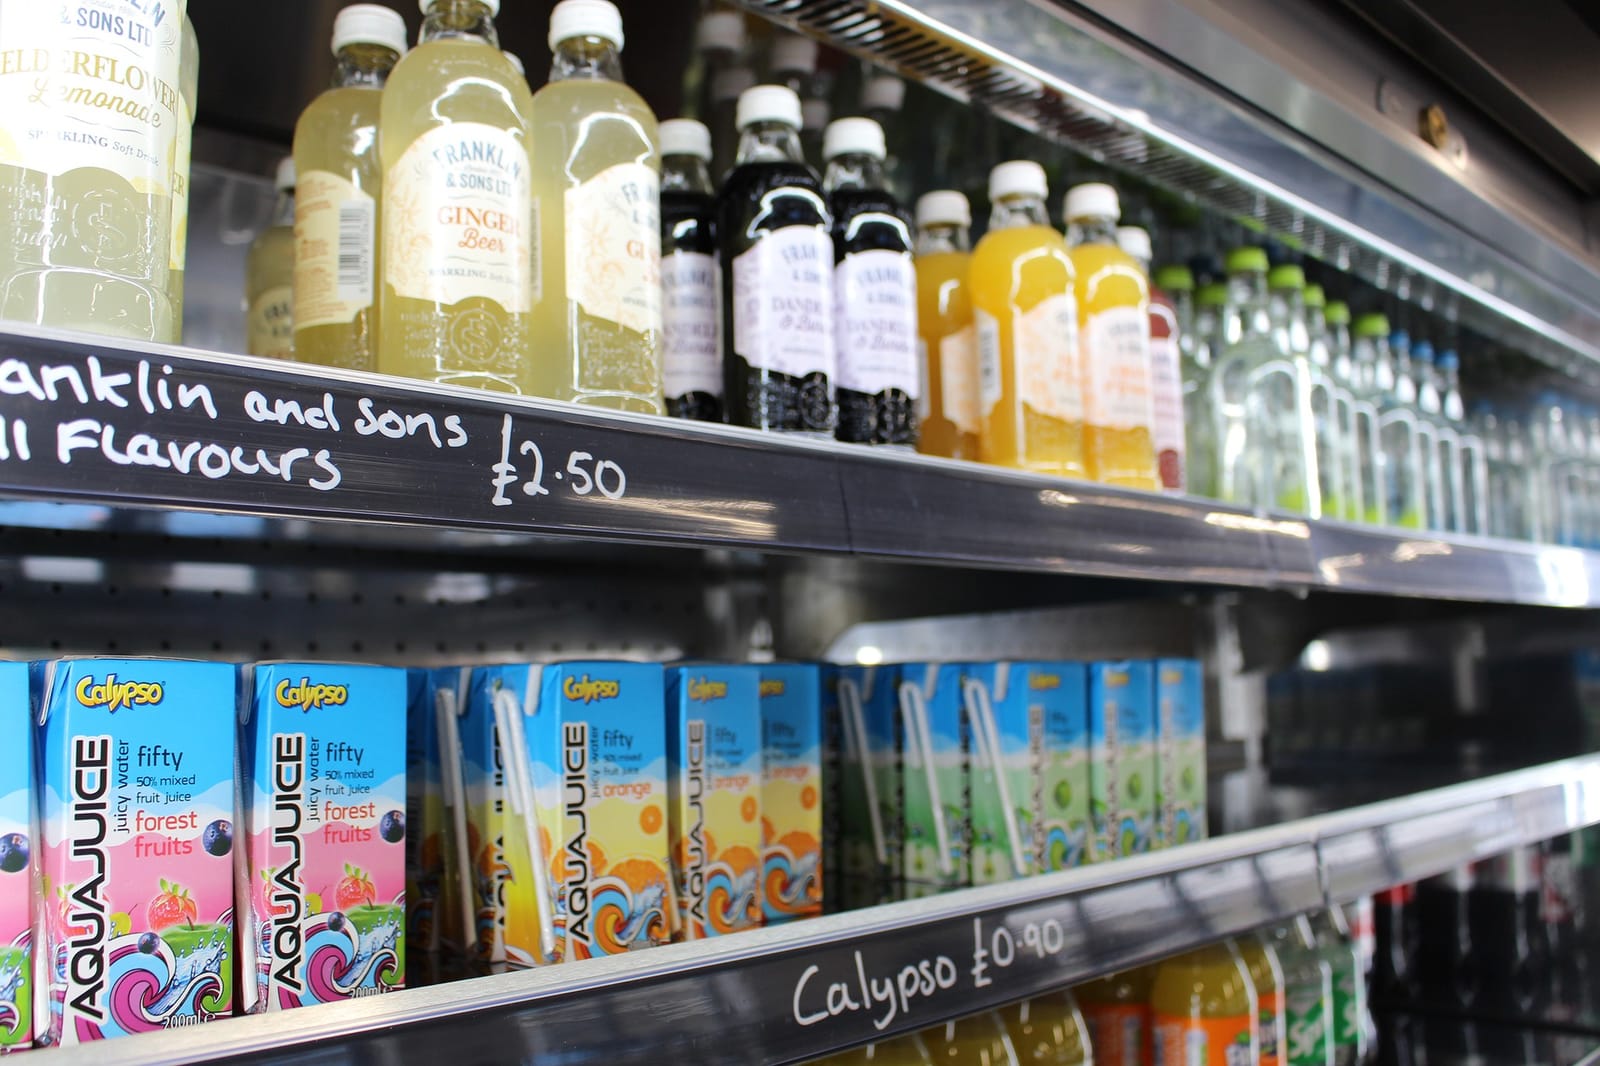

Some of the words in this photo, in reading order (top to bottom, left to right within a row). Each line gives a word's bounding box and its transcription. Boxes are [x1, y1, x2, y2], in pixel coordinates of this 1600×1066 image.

[77, 7, 125, 36] SONS
[128, 20, 153, 47] LTD
[28, 129, 109, 148] SPKLING
[112, 141, 134, 156] Soft
[459, 173, 494, 193] SONS
[438, 206, 521, 238] GINGER
[458, 227, 506, 254] Beer
[0, 355, 219, 420] anklin
[56, 418, 342, 492] Flavours
[243, 389, 341, 432] and
[491, 412, 627, 507] £2.50
[75, 673, 164, 714] Calypso
[275, 676, 349, 714] Calypso
[562, 674, 621, 704] Calypso
[325, 741, 364, 766] fifty
[603, 729, 634, 751] fifty
[115, 738, 130, 790] water
[137, 745, 184, 771] fifty
[308, 736, 320, 783] water
[136, 775, 158, 788] 50%
[159, 774, 196, 787] mixed
[325, 769, 342, 781] 50%
[343, 768, 375, 780] mixed
[325, 783, 345, 796] fruit
[347, 784, 371, 797] juice
[136, 791, 161, 805] fruit
[163, 791, 192, 806] juice
[307, 786, 321, 823] juicy
[602, 782, 652, 801] orange
[113, 794, 130, 834] juicy
[135, 810, 198, 832] forest
[324, 800, 376, 821] forest
[688, 721, 705, 921] AQUAJUICE
[135, 834, 193, 859] fruits
[323, 823, 372, 845] fruits
[565, 724, 591, 943] AQUAJUICE
[69, 737, 109, 1020] AQUAJUICE
[273, 735, 303, 992] AQUAJUICE
[793, 951, 957, 1030] Calypso
[971, 917, 1065, 988] £0.90
